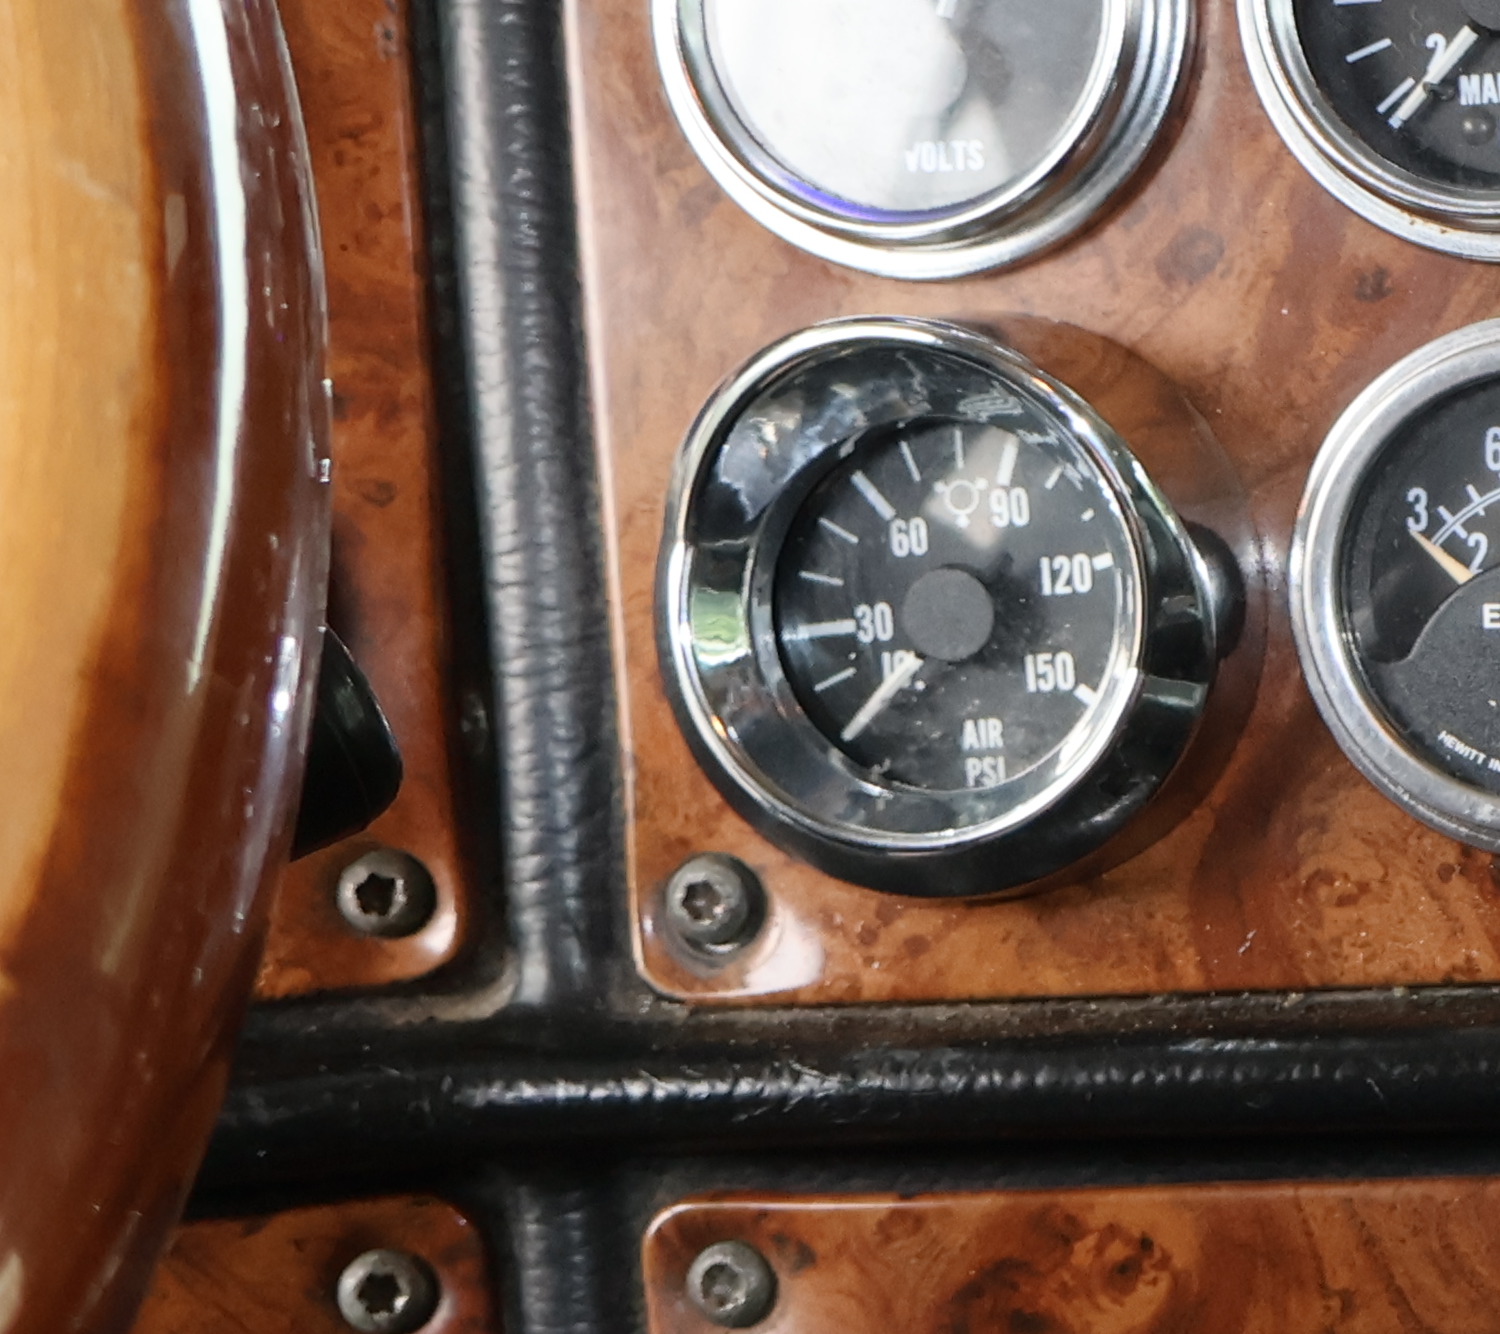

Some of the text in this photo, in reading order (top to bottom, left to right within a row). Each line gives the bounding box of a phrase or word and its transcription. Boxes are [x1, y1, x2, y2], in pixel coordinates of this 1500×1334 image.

[904, 140, 985, 172] VOLTS
[990, 490, 1030, 526] 90
[1408, 488, 1428, 531] 3
[891, 517, 928, 556] 60
[1467, 533, 1488, 575] 2
[1040, 554, 1091, 595] 120
[855, 603, 893, 642] 30
[1025, 653, 1075, 692] 150
[962, 719, 1002, 750] AIR
[1437, 730, 1486, 765] HEWITT
[965, 758, 1005, 787] PSI
